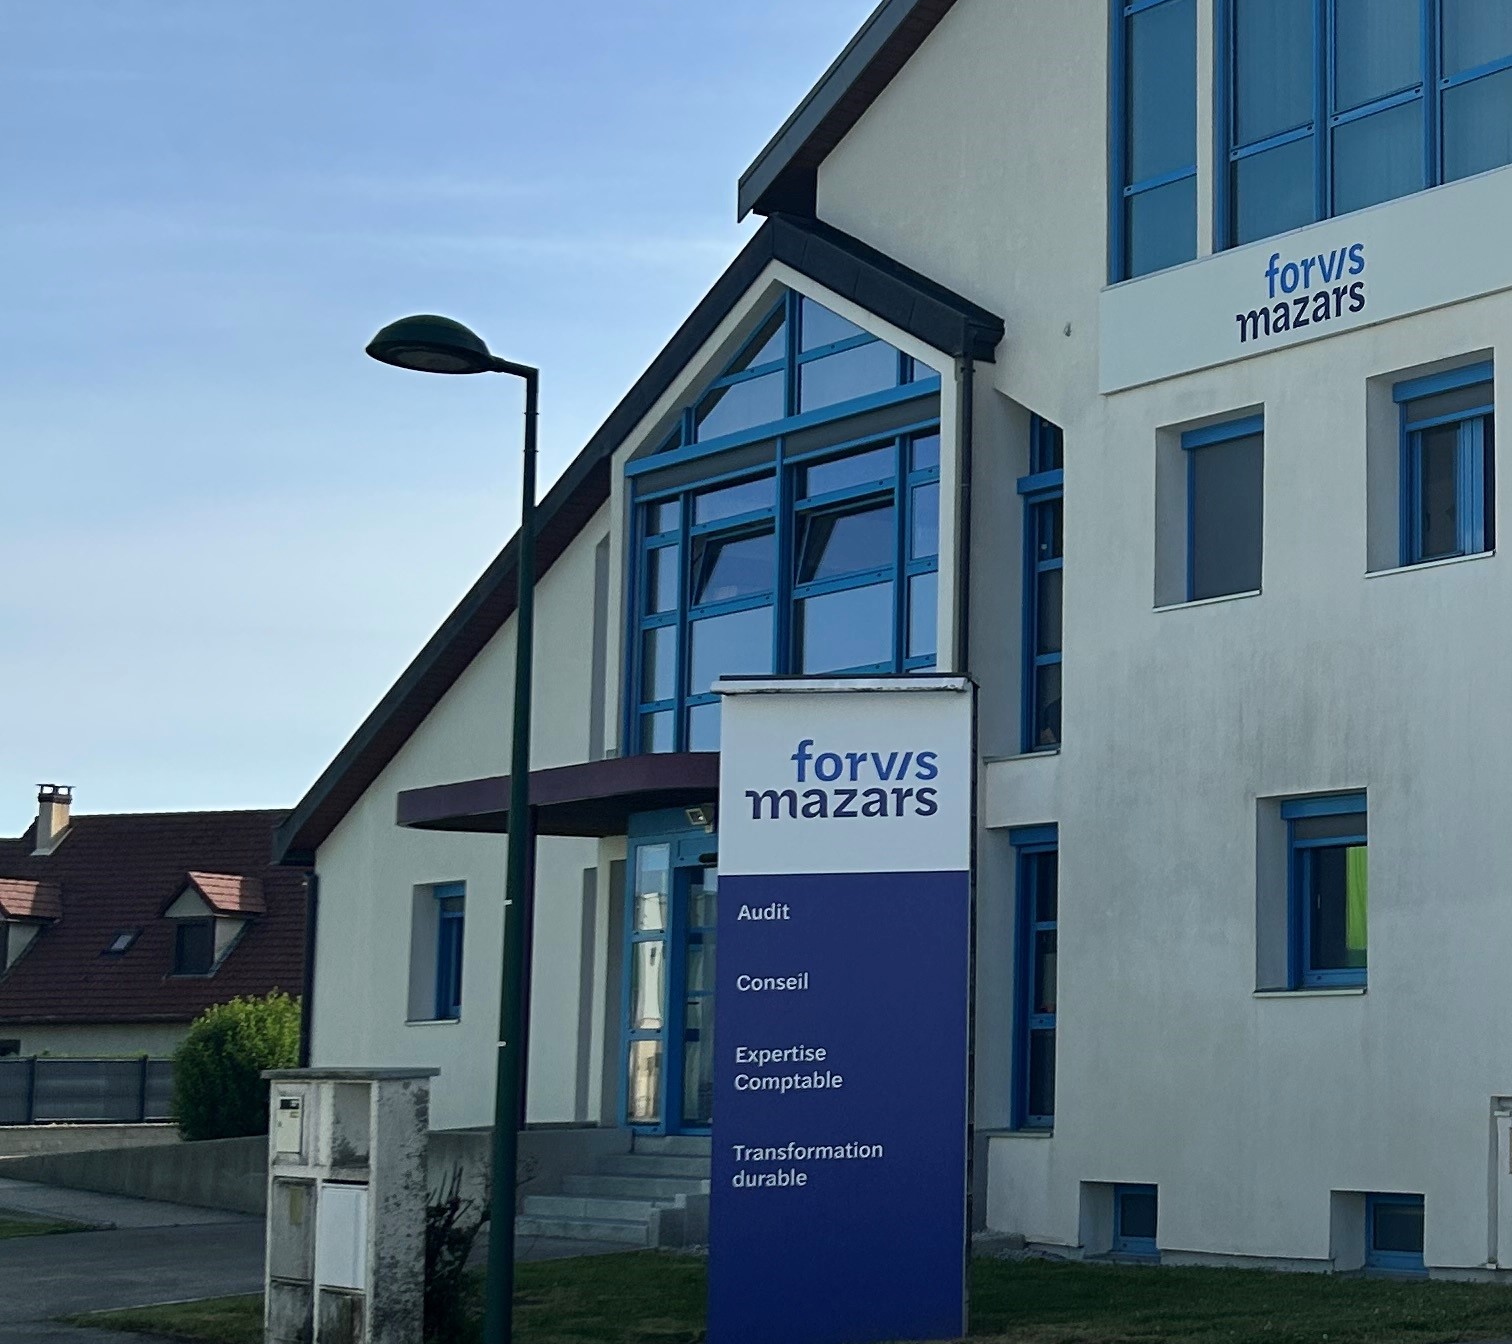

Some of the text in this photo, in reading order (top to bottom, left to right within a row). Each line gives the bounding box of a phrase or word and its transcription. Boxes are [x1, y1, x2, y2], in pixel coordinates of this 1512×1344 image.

[1235, 281, 1366, 343] mazars
[744, 786, 939, 820] mazars
[737, 902, 791, 921] Audit
[736, 972, 809, 992] Conseil
[735, 1045, 827, 1067] Expertise
[734, 1070, 843, 1094] Comptable
[732, 1141, 884, 1162] Transformation
[732, 1168, 808, 1188] durable
